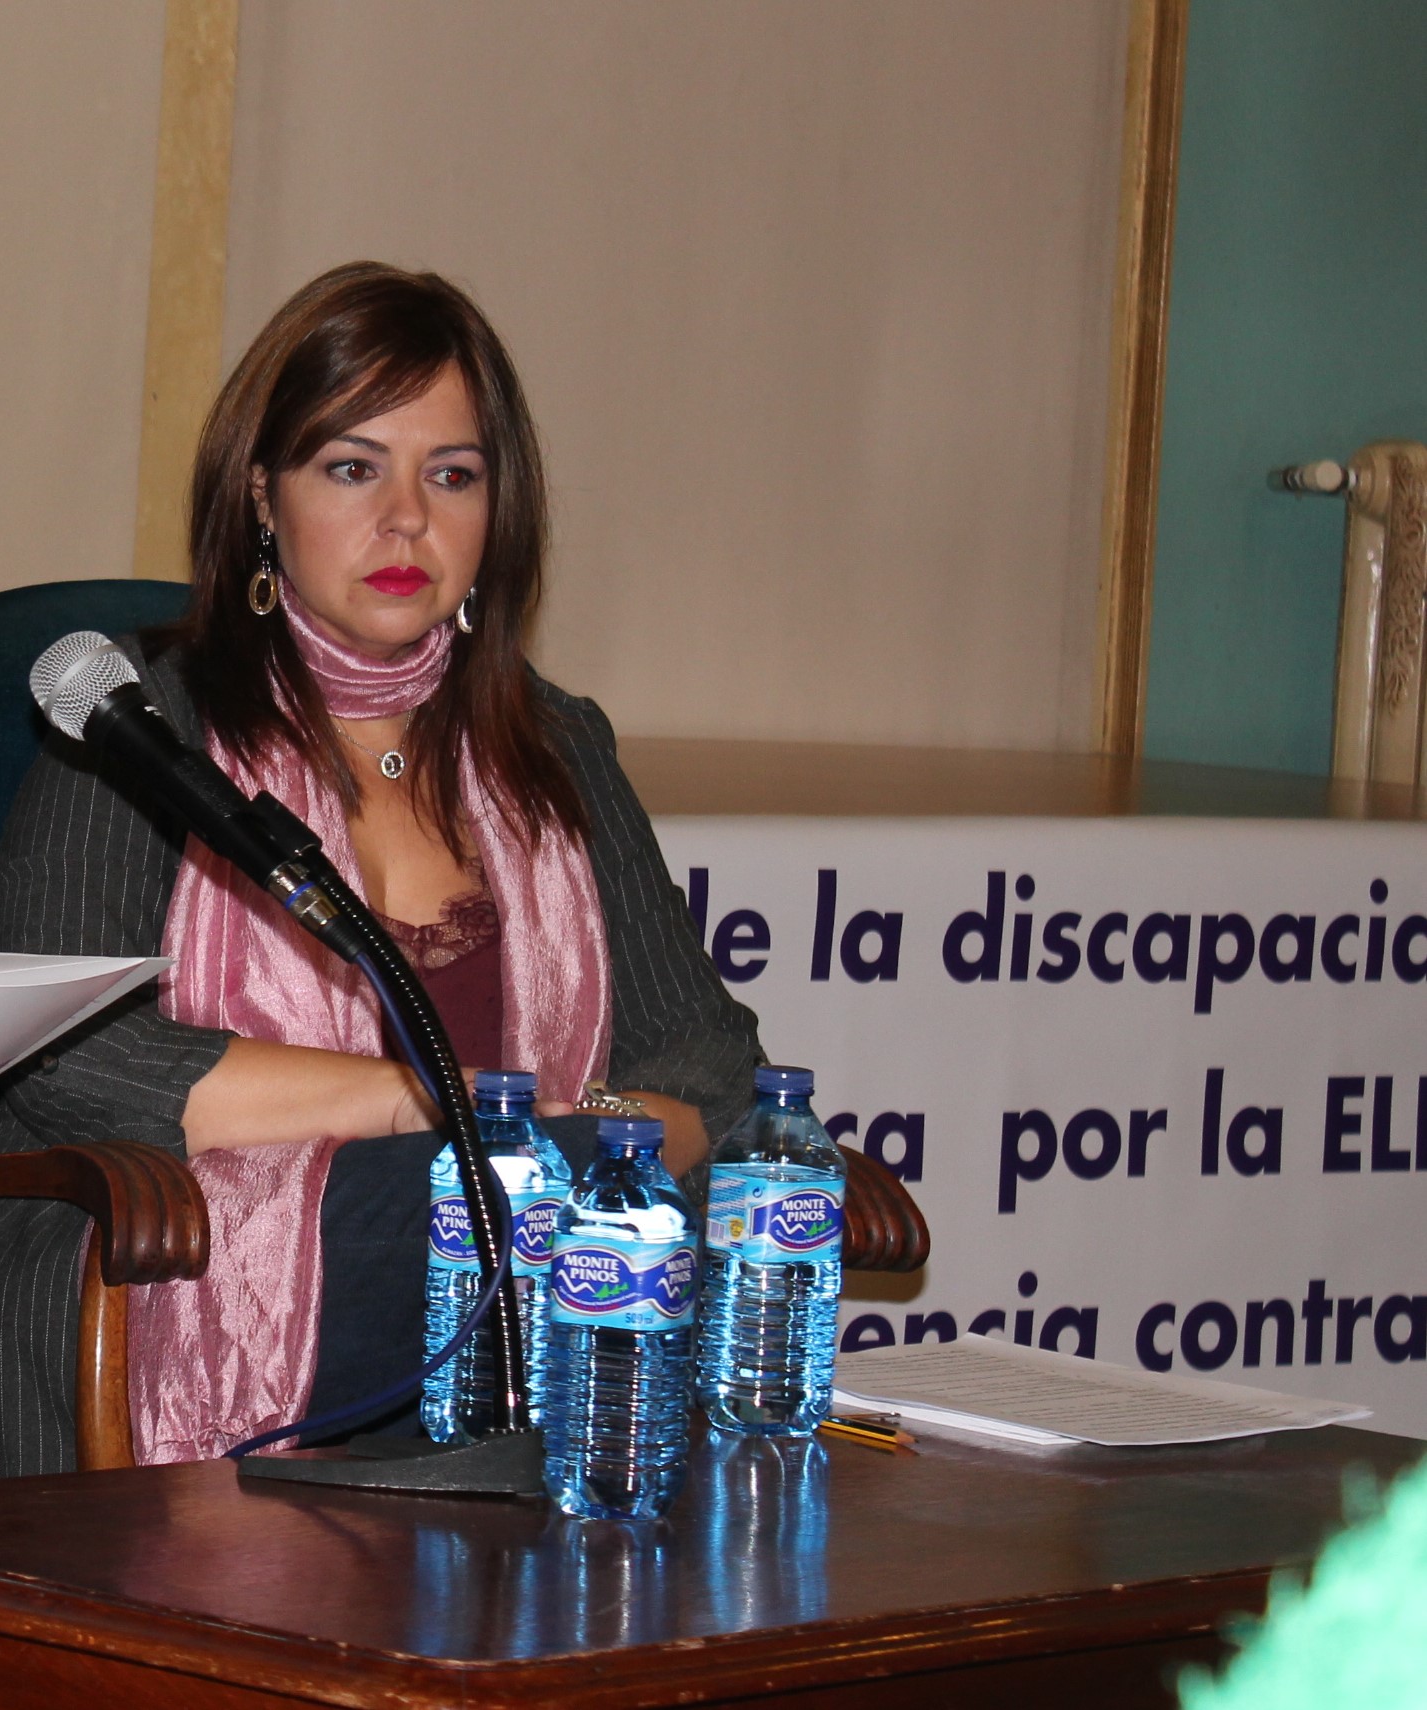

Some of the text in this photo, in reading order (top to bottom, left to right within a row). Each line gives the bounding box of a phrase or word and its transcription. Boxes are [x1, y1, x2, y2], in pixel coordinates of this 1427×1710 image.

[810, 869, 903, 983] la
[998, 1107, 1167, 1214] por
[1200, 1068, 1283, 1176] la
[1322, 1075, 1427, 1173] EL
[437, 1203, 469, 1218] MON
[781, 1198, 828, 1212] MONTE
[524, 1208, 555, 1223] MONT
[786, 1209, 826, 1223] PINOS
[442, 1216, 473, 1231] PINO
[528, 1220, 554, 1234] PINO
[564, 1254, 620, 1271] MONTE
[570, 1267, 620, 1284] PINOS
[1135, 1279, 1427, 1374] contra
